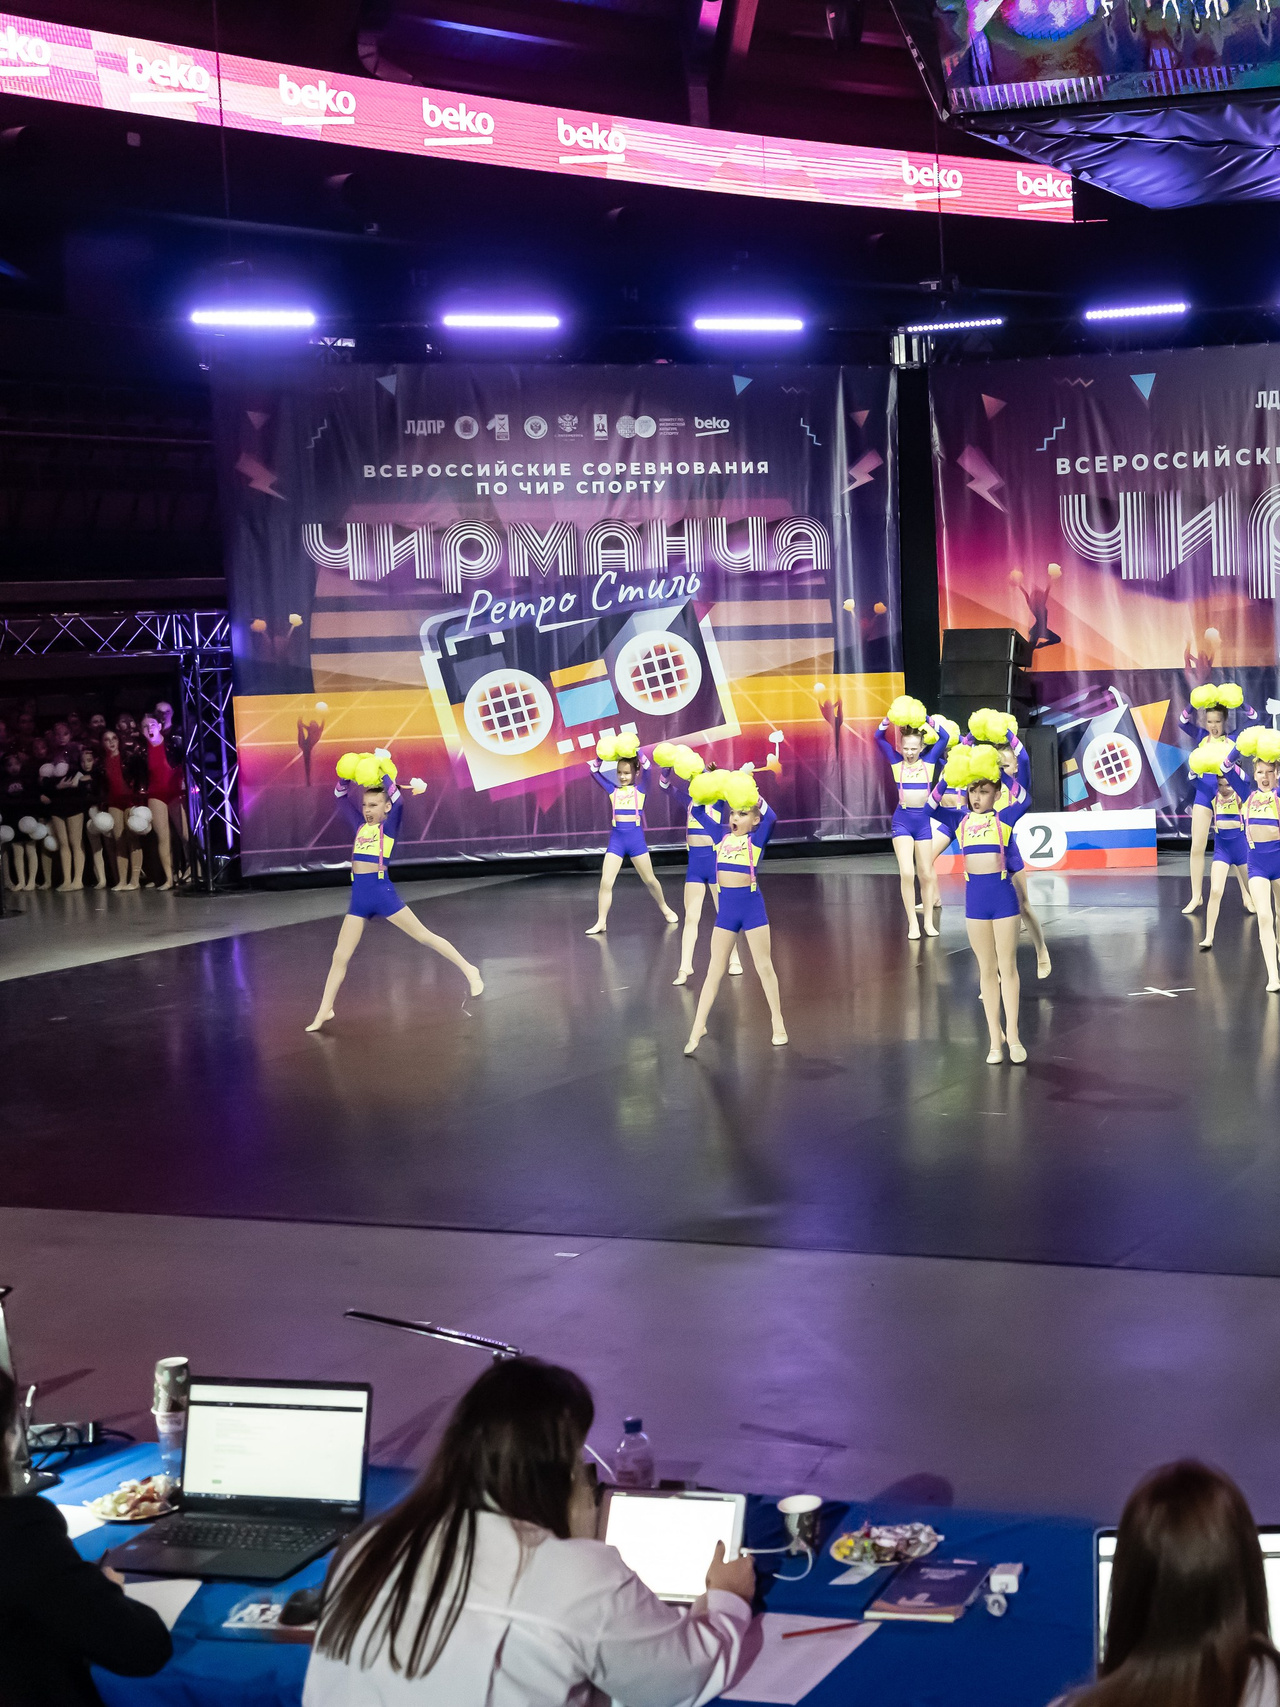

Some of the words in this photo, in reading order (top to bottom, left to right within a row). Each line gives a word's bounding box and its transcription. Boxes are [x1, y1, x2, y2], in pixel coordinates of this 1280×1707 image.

[127, 48, 210, 91] beko
[279, 74, 356, 114] beko
[422, 97, 494, 135] beko
[557, 117, 626, 153] beko
[902, 158, 963, 189] beko
[405, 419, 446, 437] ЛДПР
[694, 416, 730, 430] beko
[363, 460, 572, 478] ВСЕРОССИЙСКИЕ
[582, 460, 770, 476] СОРЕВНОВАНИЯ
[476, 481, 508, 495] ПО
[518, 481, 565, 495] ЧИР
[576, 480, 667, 495] СПОРТУ
[465, 590, 576, 632] Ретро
[592, 571, 702, 611] Стиль
[1028, 825, 1053, 859] 2
